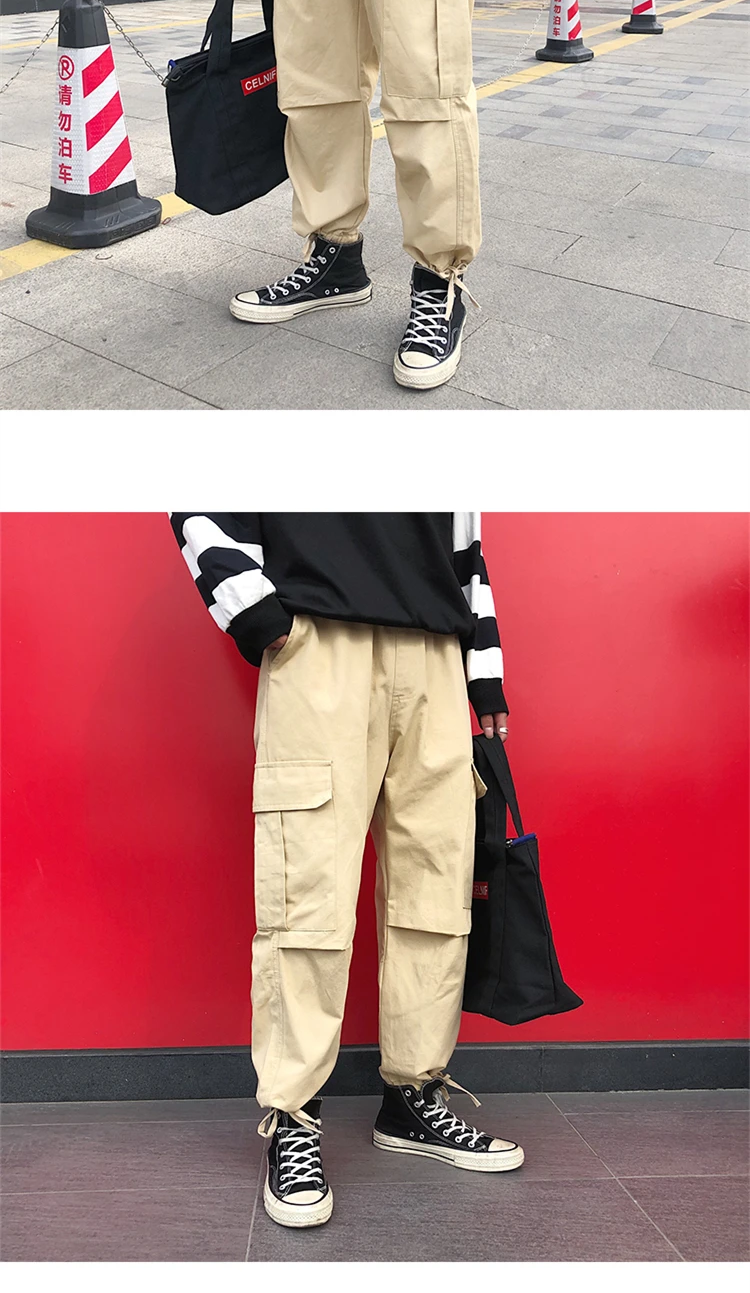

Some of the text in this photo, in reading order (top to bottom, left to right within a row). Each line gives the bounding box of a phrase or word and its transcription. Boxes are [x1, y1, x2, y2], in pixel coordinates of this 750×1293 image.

[245, 69, 276, 91] CELNIF
[58, 84, 73, 184] 请勿泊车
